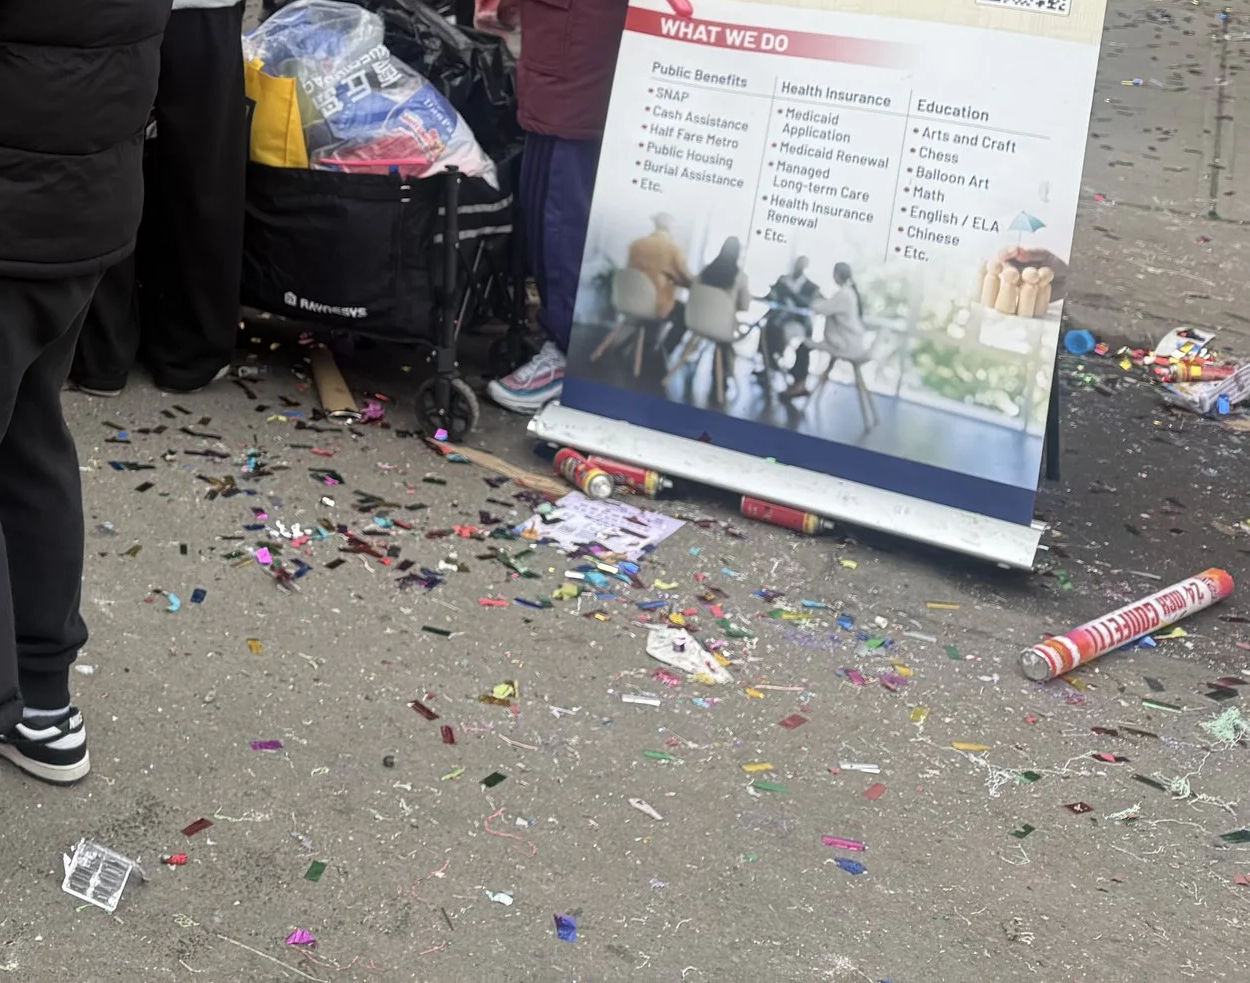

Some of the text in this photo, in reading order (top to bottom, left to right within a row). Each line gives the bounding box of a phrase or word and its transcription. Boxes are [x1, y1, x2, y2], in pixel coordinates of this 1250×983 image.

[660, 17, 789, 51] WHAT WE DO
[652, 61, 748, 88] Public Benefits
[655, 87, 690, 102] SNAP
[781, 81, 891, 107] Health Insurance
[653, 105, 749, 132] Cash Assistance
[785, 107, 840, 126] Medicaid
[917, 99, 990, 122] Education
[650, 123, 739, 150] Half Fare Metro
[782, 123, 851, 144] Application
[922, 127, 1017, 154] Arts and Craft
[646, 141, 734, 170] Public Housing
[780, 141, 889, 169] Medicaid Renewal
[919, 147, 959, 165] Chess
[643, 159, 744, 188] Burial Assistance
[776, 160, 831, 180] Managed
[916, 166, 990, 190] Balloon Art
[773, 175, 870, 202] Long-term Care
[913, 186, 945, 202] Math
[767, 209, 818, 229] Renewal
[770, 194, 874, 223] Health Insurance
[910, 205, 1000, 233] English ELA
[907, 225, 960, 246] Chinese
[1155, 590, 1188, 616] INCH
[1085, 607, 1160, 653] CONFETTI
